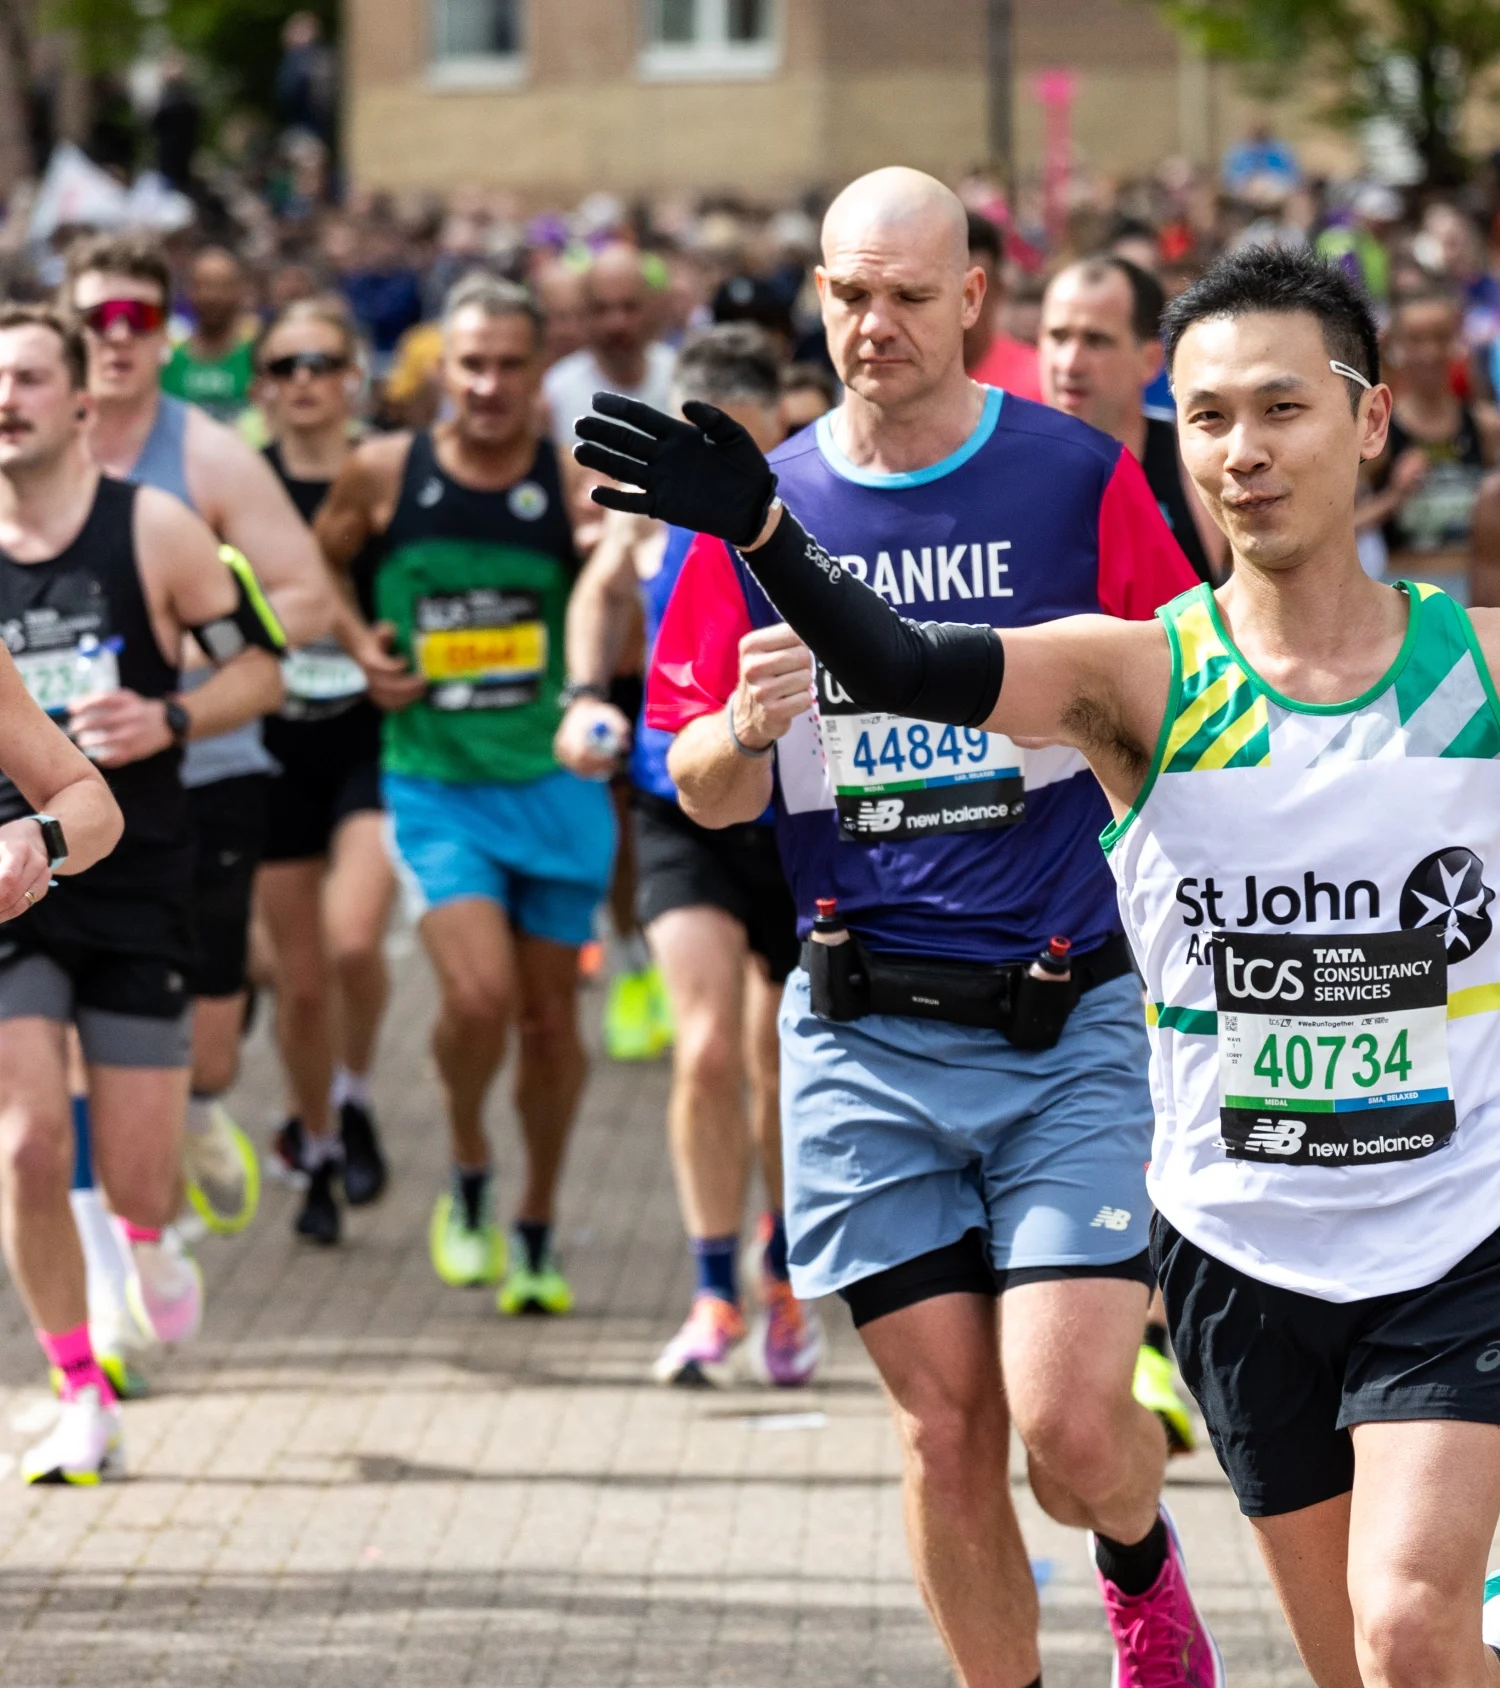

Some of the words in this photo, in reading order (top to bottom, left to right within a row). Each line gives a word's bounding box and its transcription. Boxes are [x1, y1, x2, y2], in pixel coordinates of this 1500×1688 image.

[838, 540, 1014, 606] RANKIE
[853, 723, 989, 777] 44849
[906, 813, 941, 829] new
[942, 804, 1009, 824] balance
[1175, 877, 1227, 927] St
[1236, 871, 1380, 928] John
[1312, 948, 1367, 963] TATA
[1313, 960, 1433, 983] CONSULTANCY
[1225, 946, 1305, 1001] tcs
[1314, 984, 1391, 1002] SERVICES
[1253, 1028, 1413, 1090] 40734
[1264, 1098, 1288, 1107] MEDAL
[1367, 1096, 1385, 1105] SMA,
[1386, 1091, 1419, 1101] RELAXED
[1244, 1118, 1307, 1156] NB
[1308, 1142, 1349, 1158] new
[1353, 1134, 1435, 1156] balance
